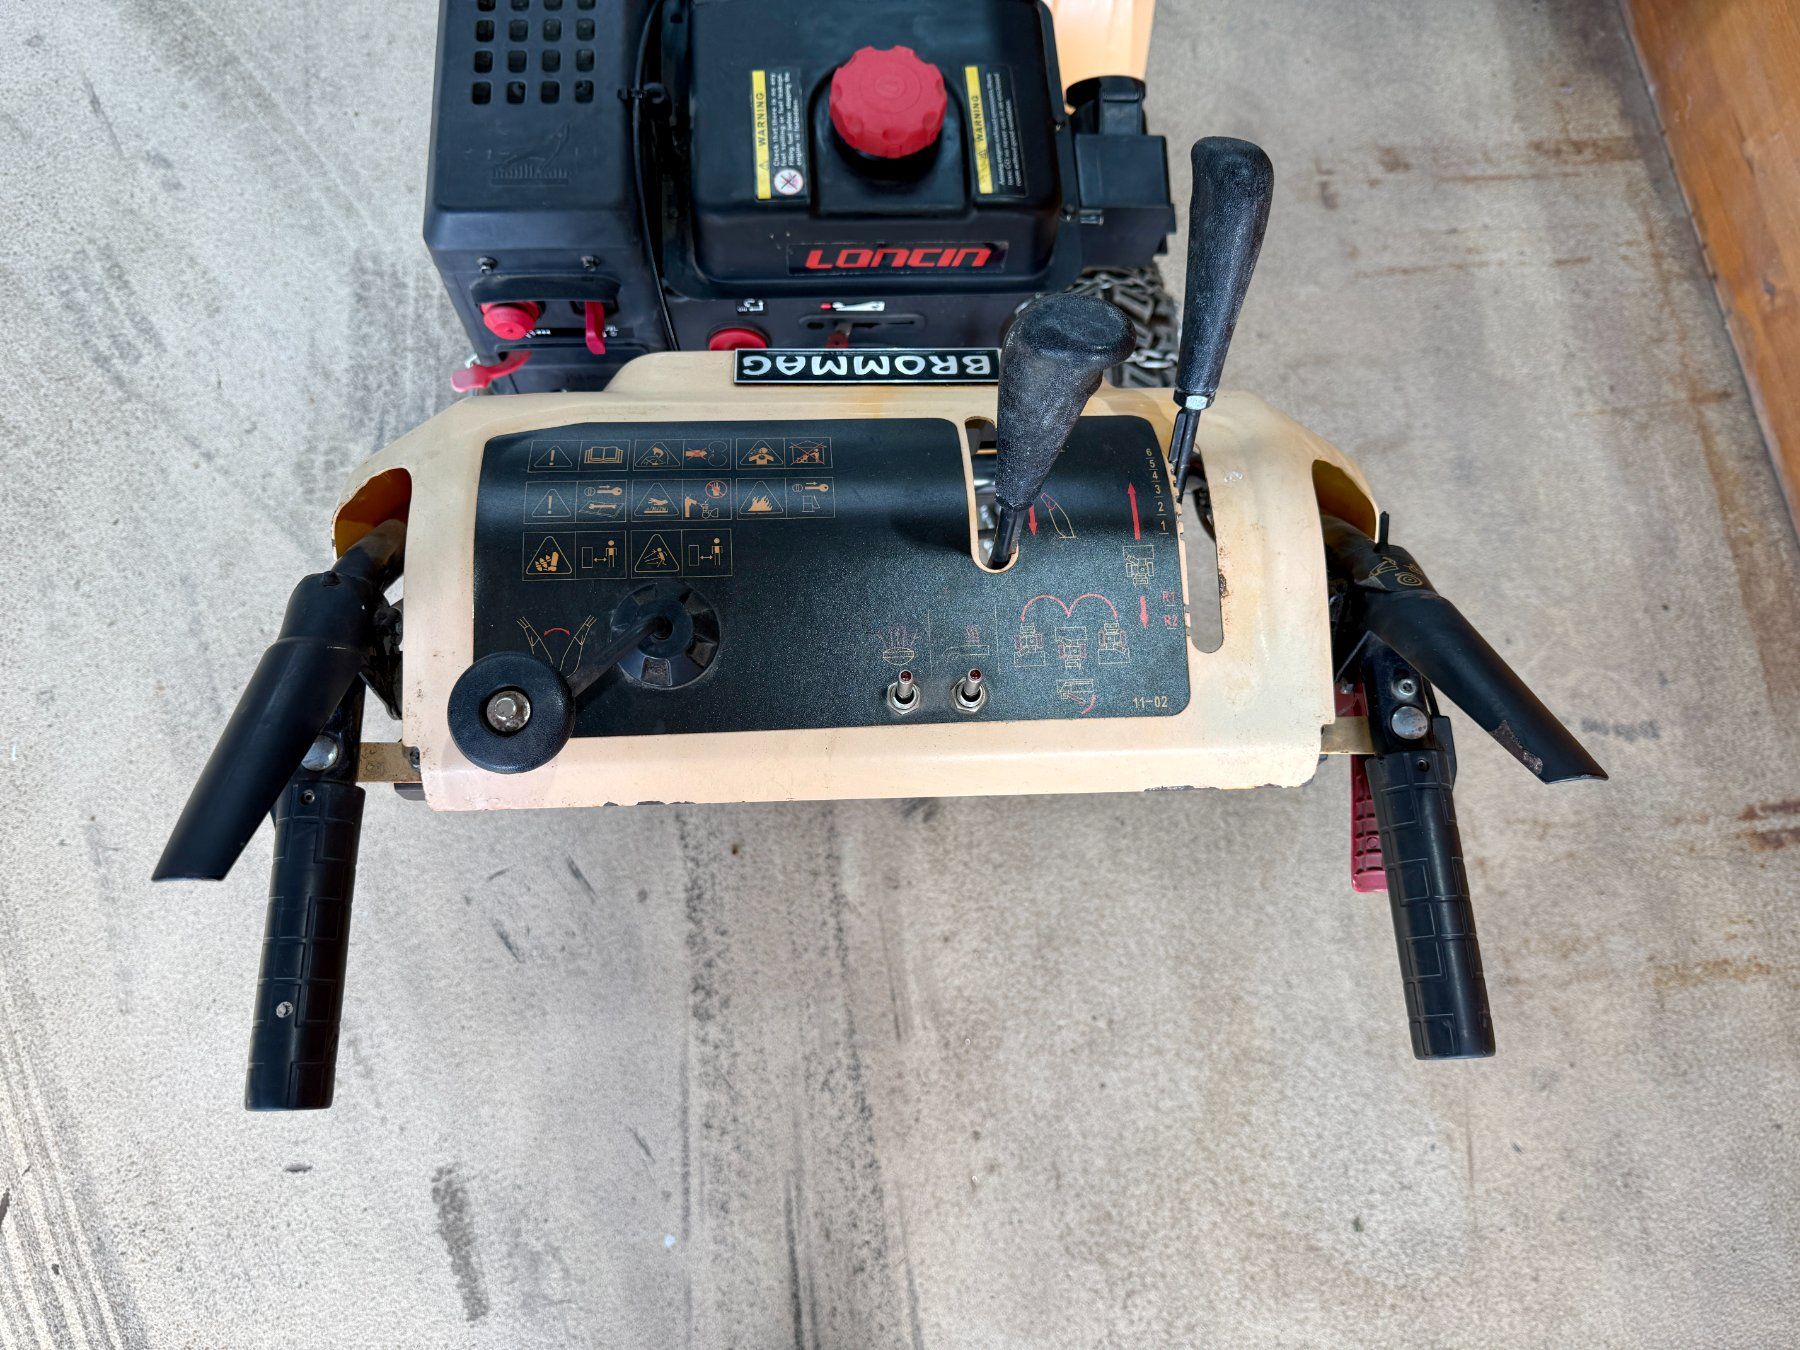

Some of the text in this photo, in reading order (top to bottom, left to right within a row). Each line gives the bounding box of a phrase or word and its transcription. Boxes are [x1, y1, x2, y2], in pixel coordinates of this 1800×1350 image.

[756, 93, 766, 146] WARNING
[971, 95, 984, 141] WARNING
[805, 248, 992, 270] LONCIN
[742, 355, 991, 375] BROMMAG
[1145, 448, 1153, 457] 6
[1149, 460, 1156, 468] 5
[1152, 472, 1158, 480] 4
[1154, 485, 1161, 495] 3
[1157, 502, 1164, 512] 2
[1160, 520, 1166, 531] 1
[1162, 591, 1175, 602] R1
[1163, 615, 1178, 627] R2
[1133, 696, 1168, 709] 11-02
